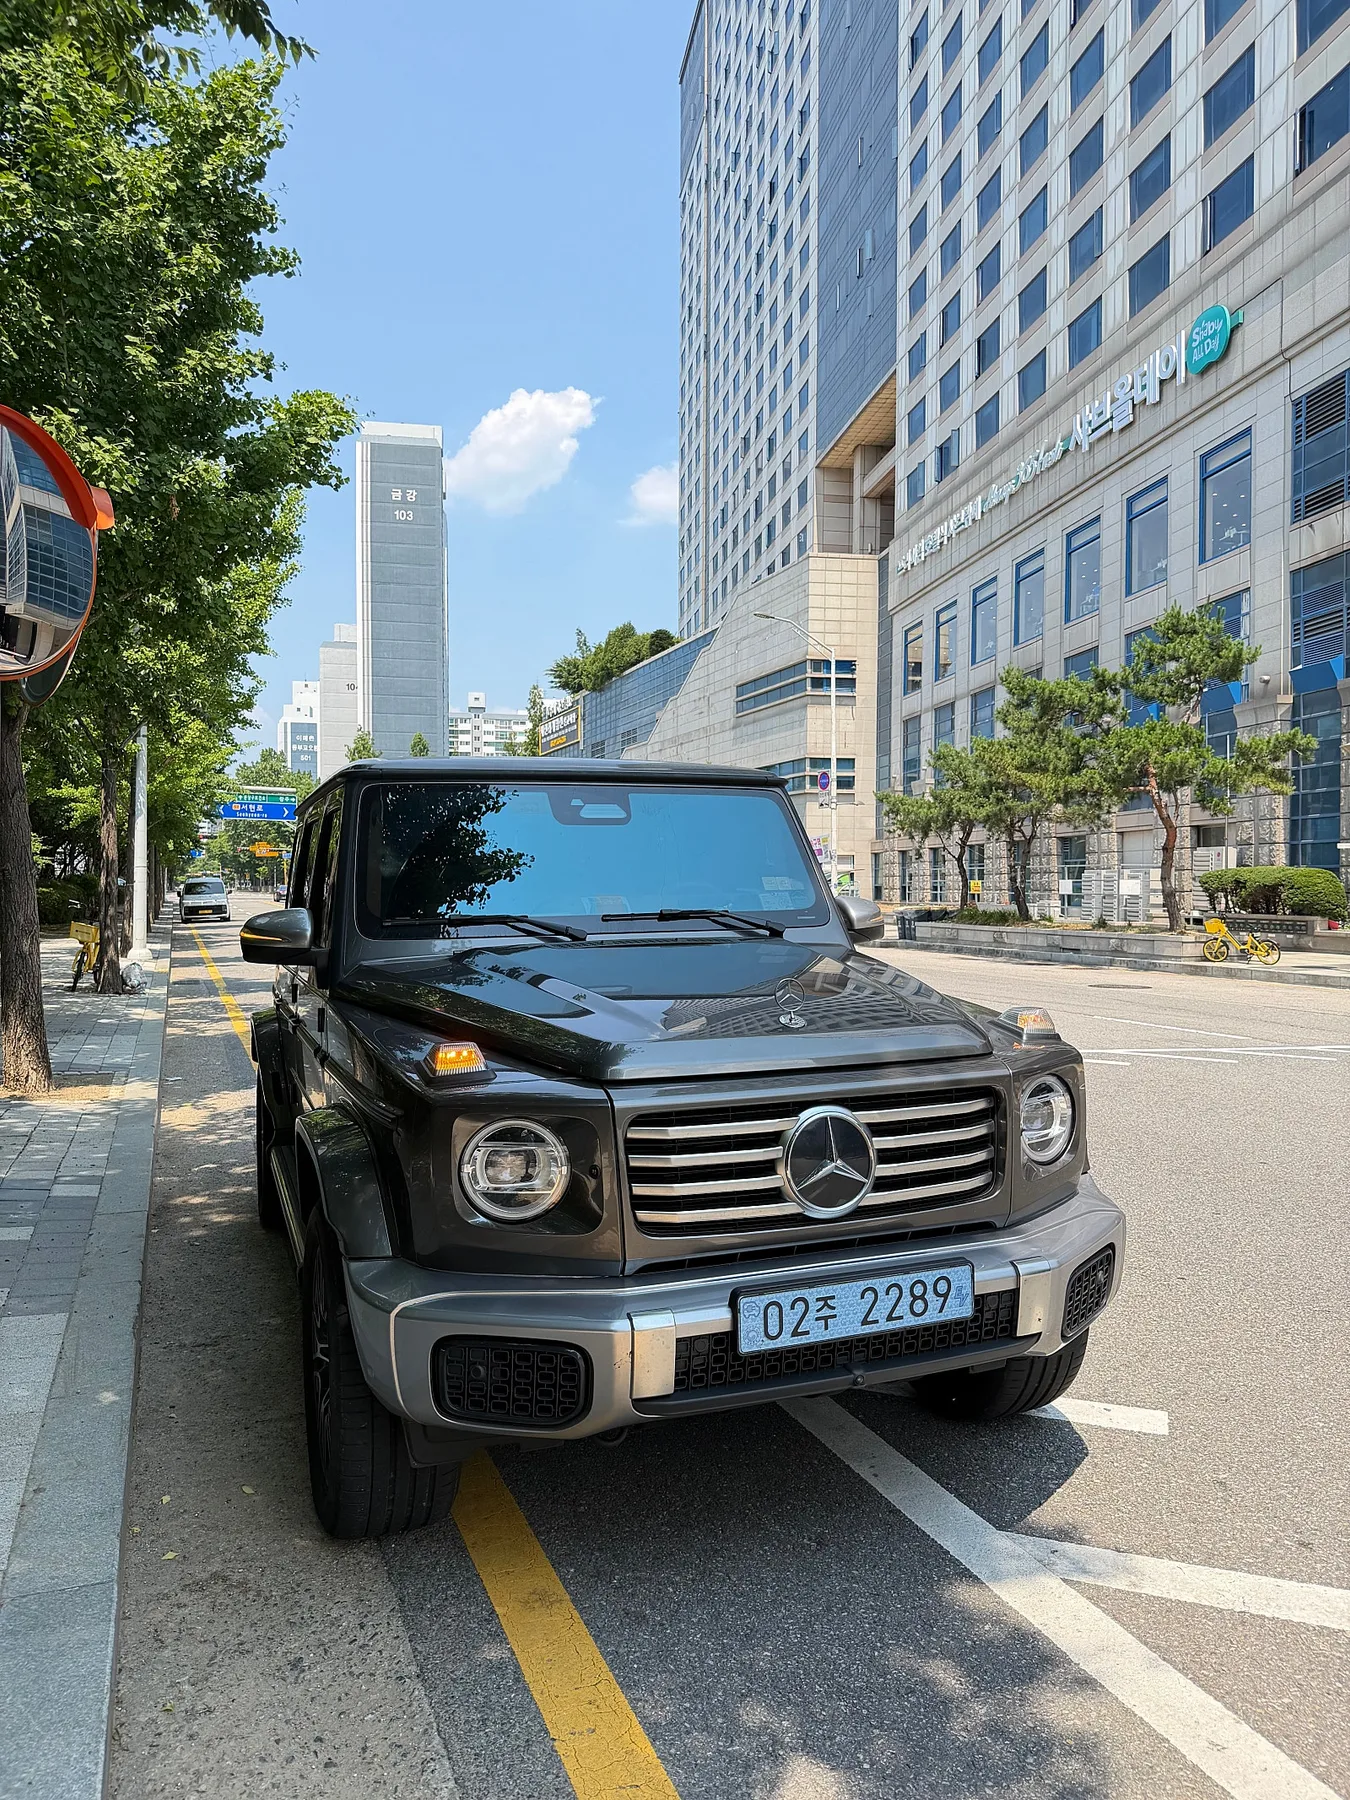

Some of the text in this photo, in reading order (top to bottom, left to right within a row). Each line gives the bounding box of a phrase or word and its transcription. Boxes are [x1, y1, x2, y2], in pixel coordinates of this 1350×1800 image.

[1069, 330, 1186, 453] 샤브올데이
[394, 509, 413, 521] 103
[345, 683, 358, 691] 10
[241, 803, 263, 812] 서현로
[763, 1275, 952, 1341] 02주 2289
